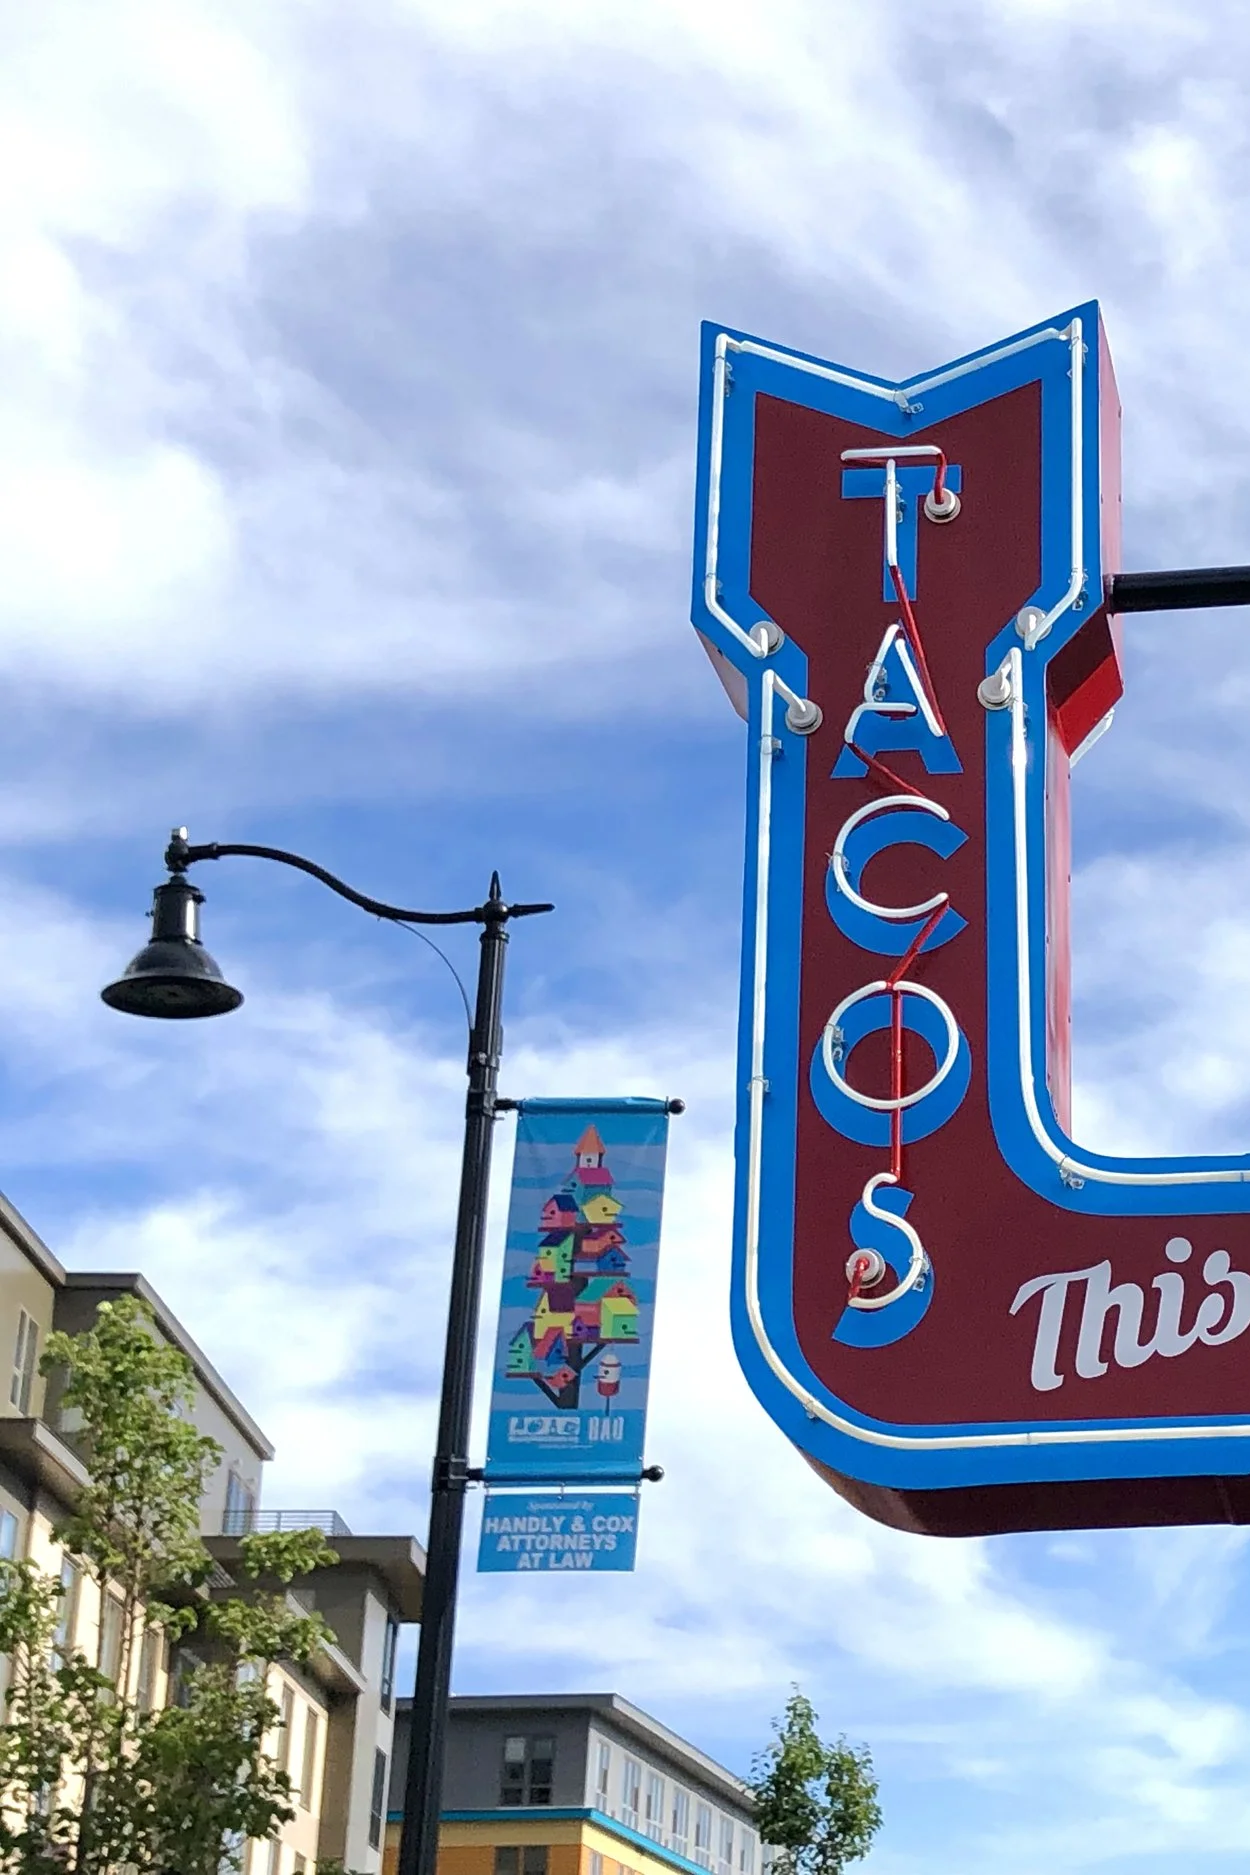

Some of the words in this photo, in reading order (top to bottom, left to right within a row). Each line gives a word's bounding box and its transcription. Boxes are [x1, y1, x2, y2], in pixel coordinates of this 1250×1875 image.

[810, 447, 971, 1348] TACOS
[484, 1516, 566, 1533] HANDLY
[570, 1515, 586, 1533] &
[592, 1515, 635, 1533] COX
[496, 1534, 617, 1552] ATTORNEYS
[517, 1552, 544, 1569] AT
[549, 1552, 594, 1569] LAW
